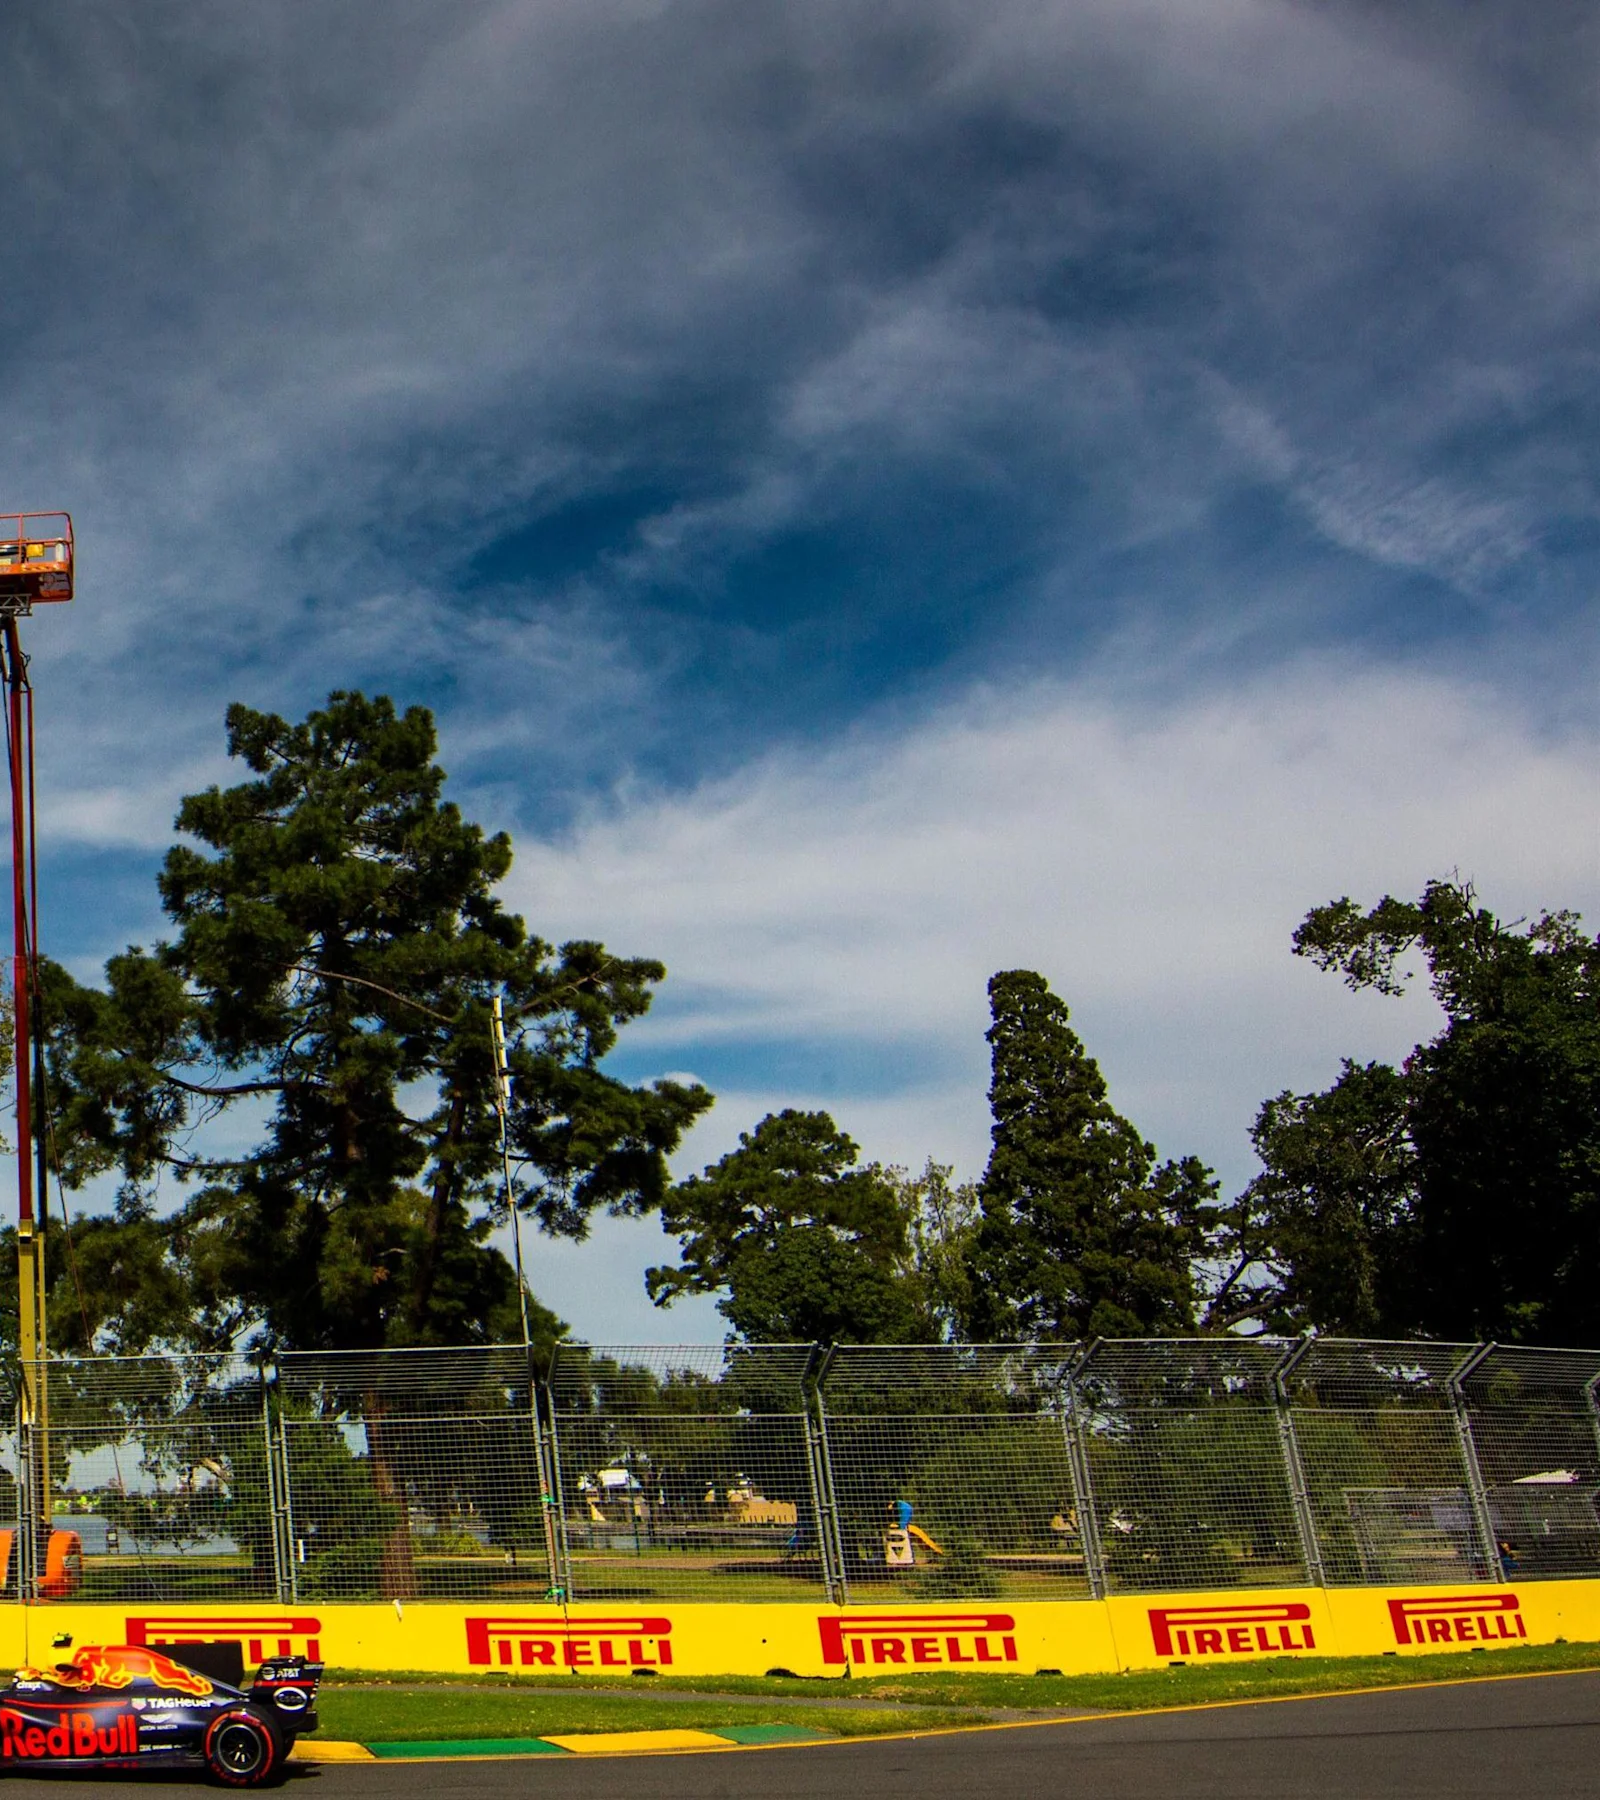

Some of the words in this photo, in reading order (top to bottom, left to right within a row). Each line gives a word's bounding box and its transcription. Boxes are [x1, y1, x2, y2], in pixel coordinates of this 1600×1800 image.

[126, 1617, 321, 1664] PLLI
[465, 1617, 672, 1666] PIRELLI
[818, 1614, 1018, 1664] PIRELLI
[1148, 1603, 1315, 1656] PIRELLI
[1387, 1594, 1527, 1644] PIRELLI
[276, 1667, 300, 1678] AT&T
